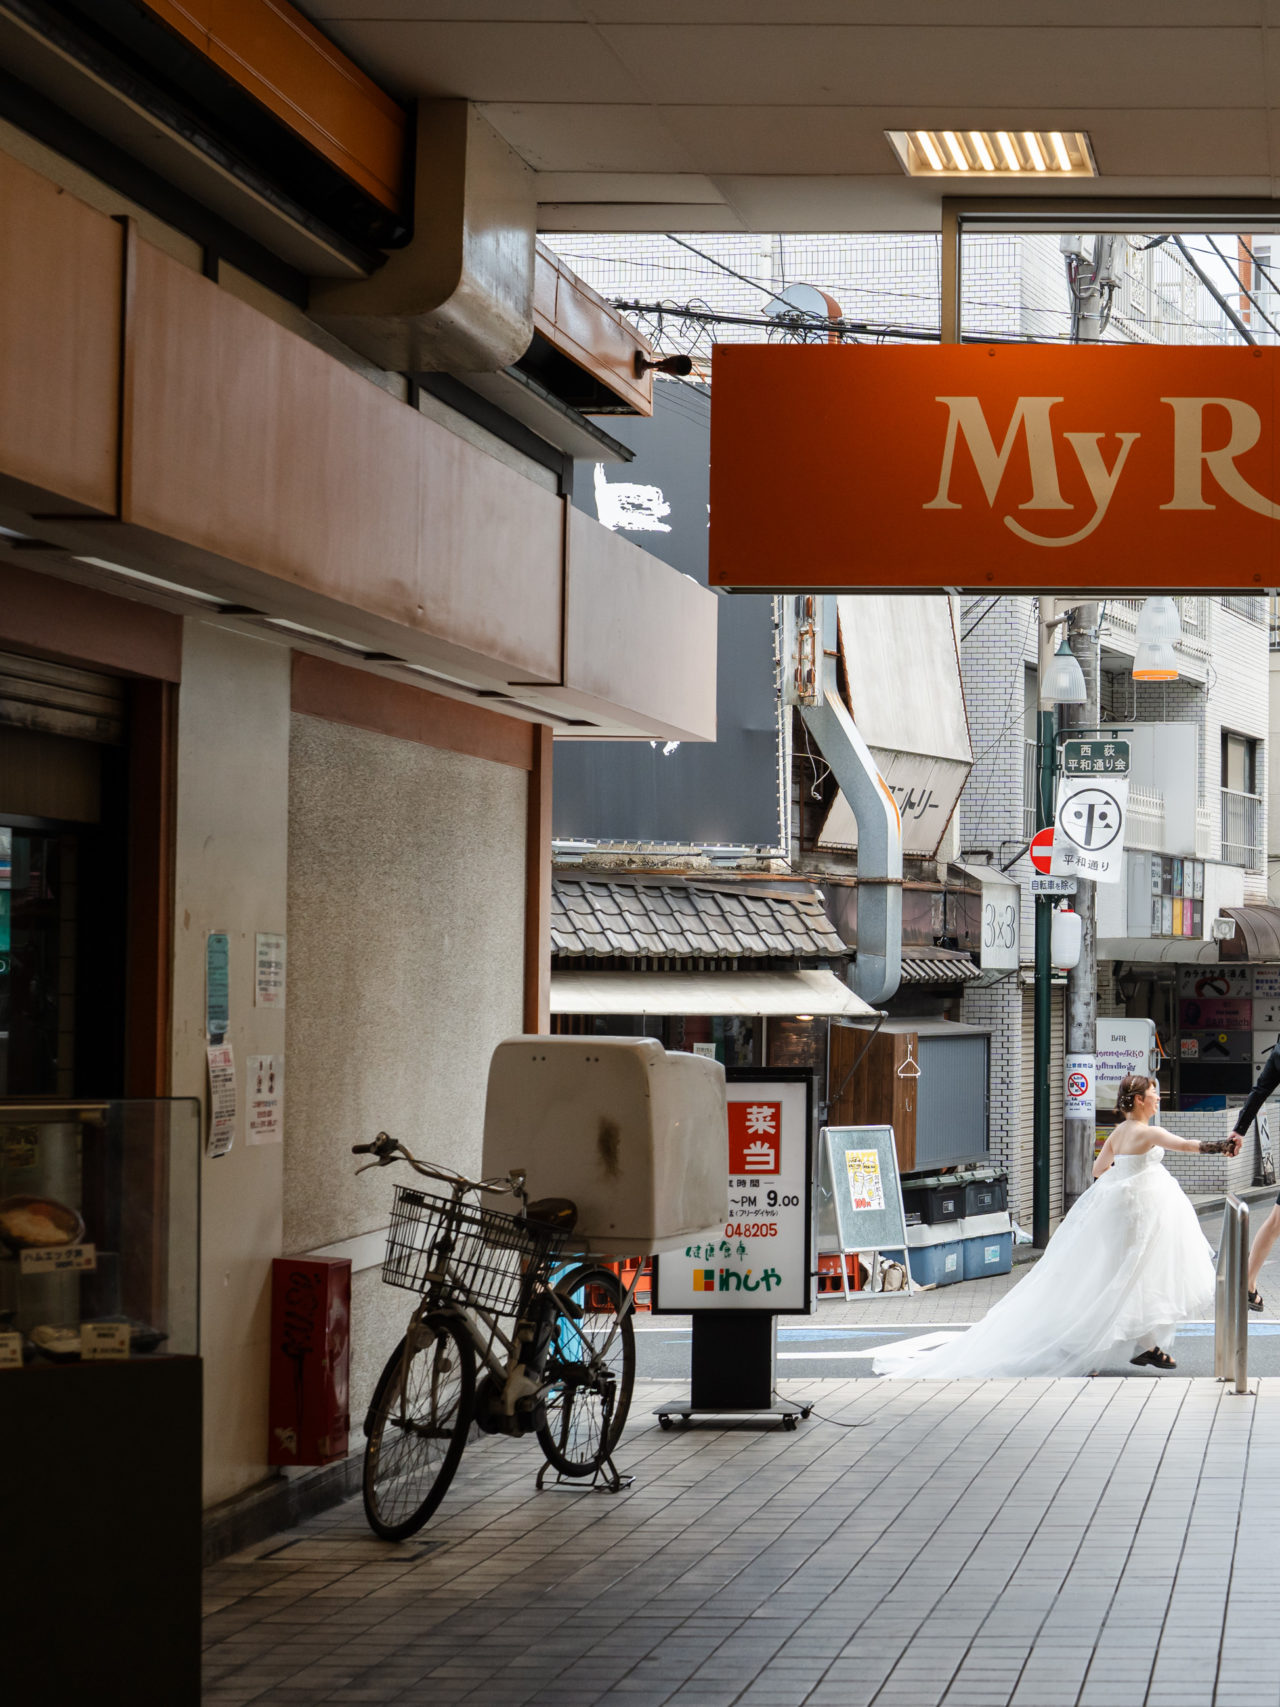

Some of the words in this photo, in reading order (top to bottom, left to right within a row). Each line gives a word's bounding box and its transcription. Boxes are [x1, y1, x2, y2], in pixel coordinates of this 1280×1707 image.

[922, 396, 1141, 547] My
[1080, 744, 1116, 757] 西荻
[1067, 759, 1126, 771] 平和通り会
[1063, 854, 1110, 872] 平和通り
[1031, 880, 1075, 890] 自転車を除く
[745, 1105, 776, 1134] 菜
[743, 1141, 776, 1171] 当
[725, 1222, 778, 1238] 048205
